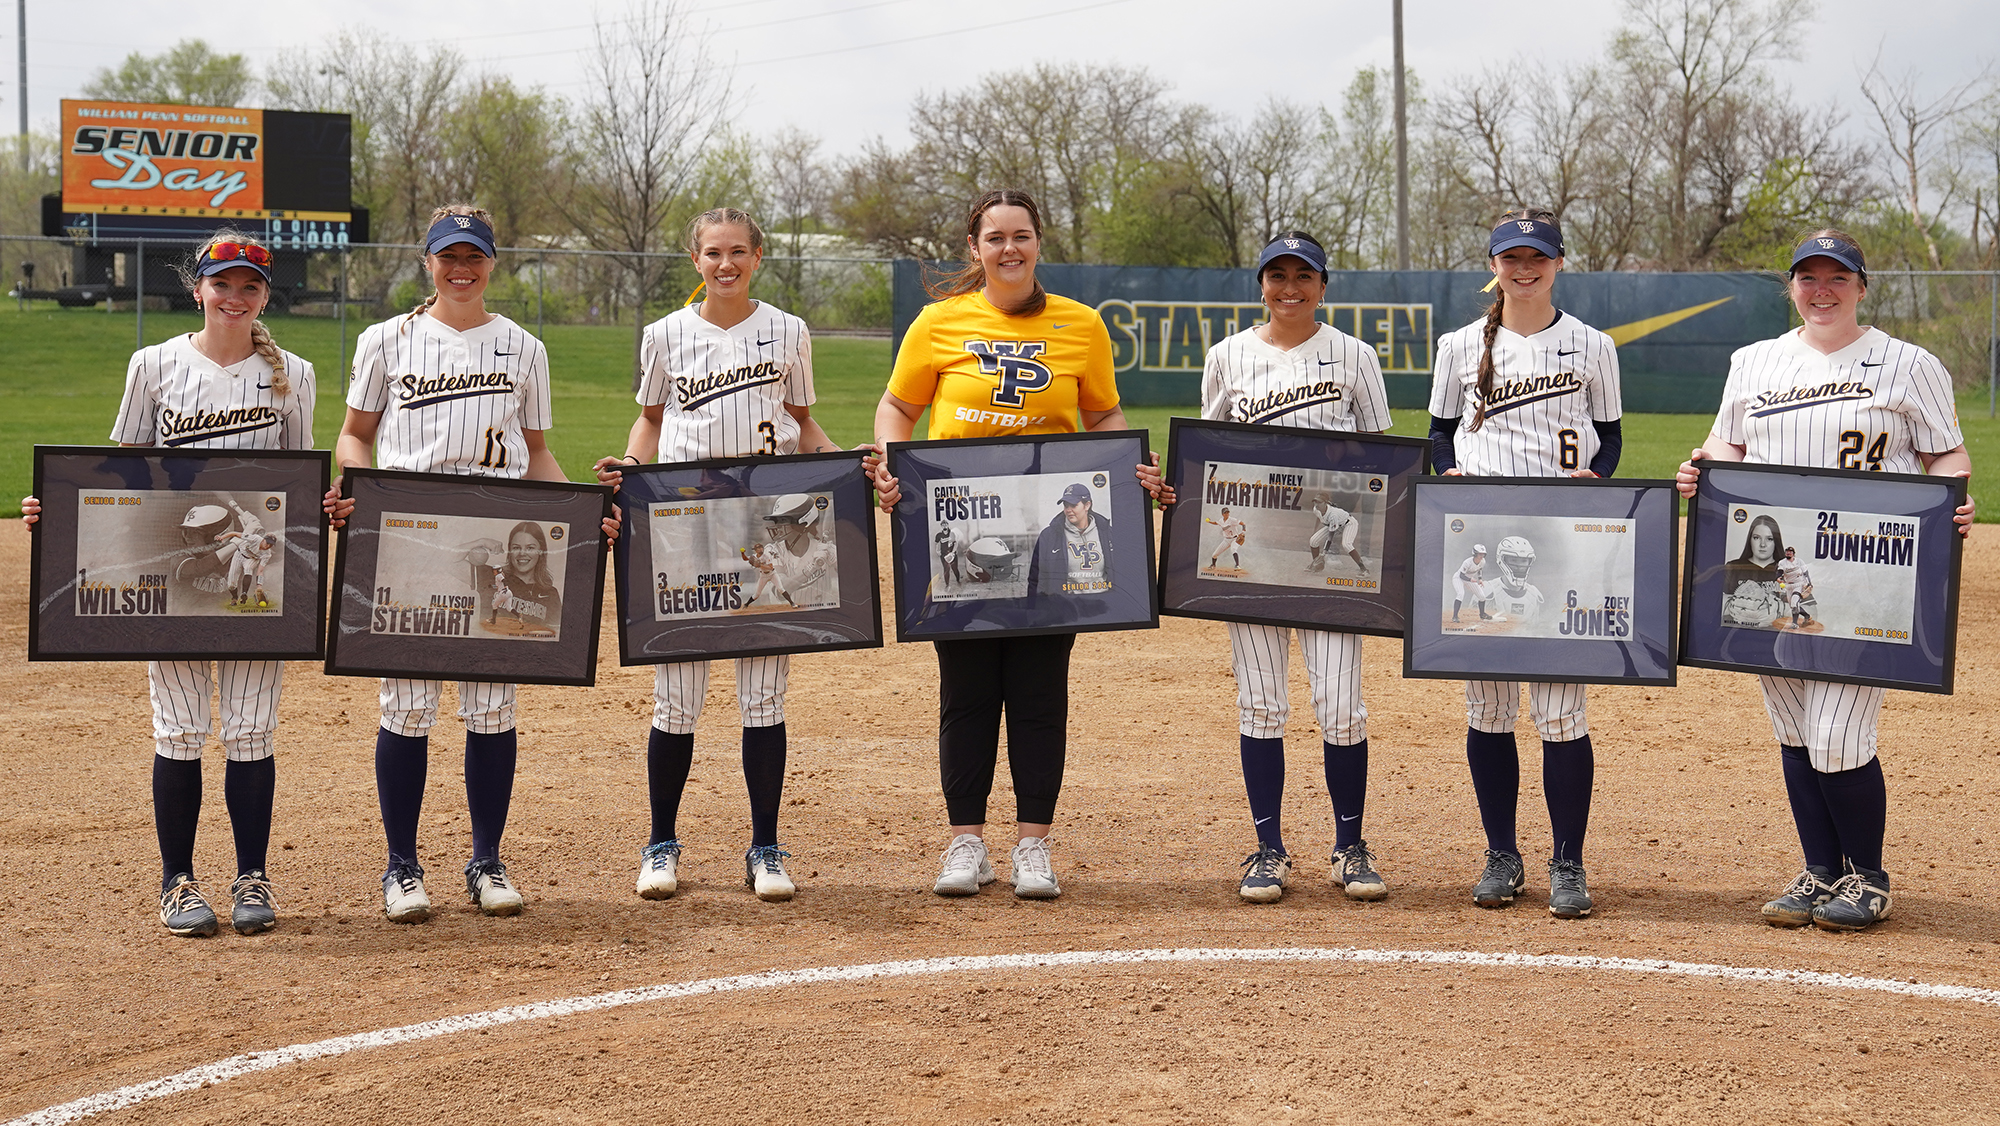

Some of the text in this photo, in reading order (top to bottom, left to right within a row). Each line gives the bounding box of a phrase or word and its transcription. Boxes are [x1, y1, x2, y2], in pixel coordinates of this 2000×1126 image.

[78, 108, 249, 125] WILLIAM PENN SOFTBALL
[72, 125, 260, 162] SENIOR
[91, 147, 248, 208] Day
[1517, 220, 1534, 234] WP
[1817, 238, 1834, 249] WP
[400, 372, 513, 401] Statesmen
[676, 361, 782, 404] Statesmen
[963, 339, 1054, 409] WP
[1238, 380, 1341, 423] Statesmen
[1751, 381, 1873, 410] Statesmen
[161, 406, 276, 437] Statesmen
[954, 406, 1047, 428] SOFTBALL
[479, 427, 507, 468] 11
[757, 420, 777, 456] 3
[1558, 428, 1578, 470] 6
[1839, 430, 1888, 472] 24
[1208, 464, 1218, 480] 7
[1269, 473, 1303, 486] NAYELY
[84, 496, 142, 506] SENIOR 2024
[934, 485, 970, 498] CAITLYN
[1206, 483, 1303, 510] MARTINEZ
[654, 507, 704, 517] SENIOR 2024
[935, 495, 1002, 522] FOSTER
[386, 519, 438, 529] SENIOR 2024
[1574, 524, 1627, 534] SENIOR 2024
[1817, 512, 1914, 538] 24 KARAH
[1068, 541, 1101, 570] WP
[1814, 532, 1914, 566] DUNHAM
[79, 568, 168, 588] 1 ABBY
[658, 572, 740, 590] 3 CHARLEY
[1062, 582, 1089, 591] SENIOR
[1326, 577, 1376, 588] SENIOR 2024
[79, 588, 168, 615] WILSON
[376, 587, 475, 609] 11 ALLYSON
[659, 585, 742, 615] GEGUZIS
[1566, 590, 1630, 610] 6 ZOEY
[373, 607, 474, 636] STEWART
[1559, 610, 1630, 637] JONES
[1854, 627, 1908, 639] SENIOR 2024
